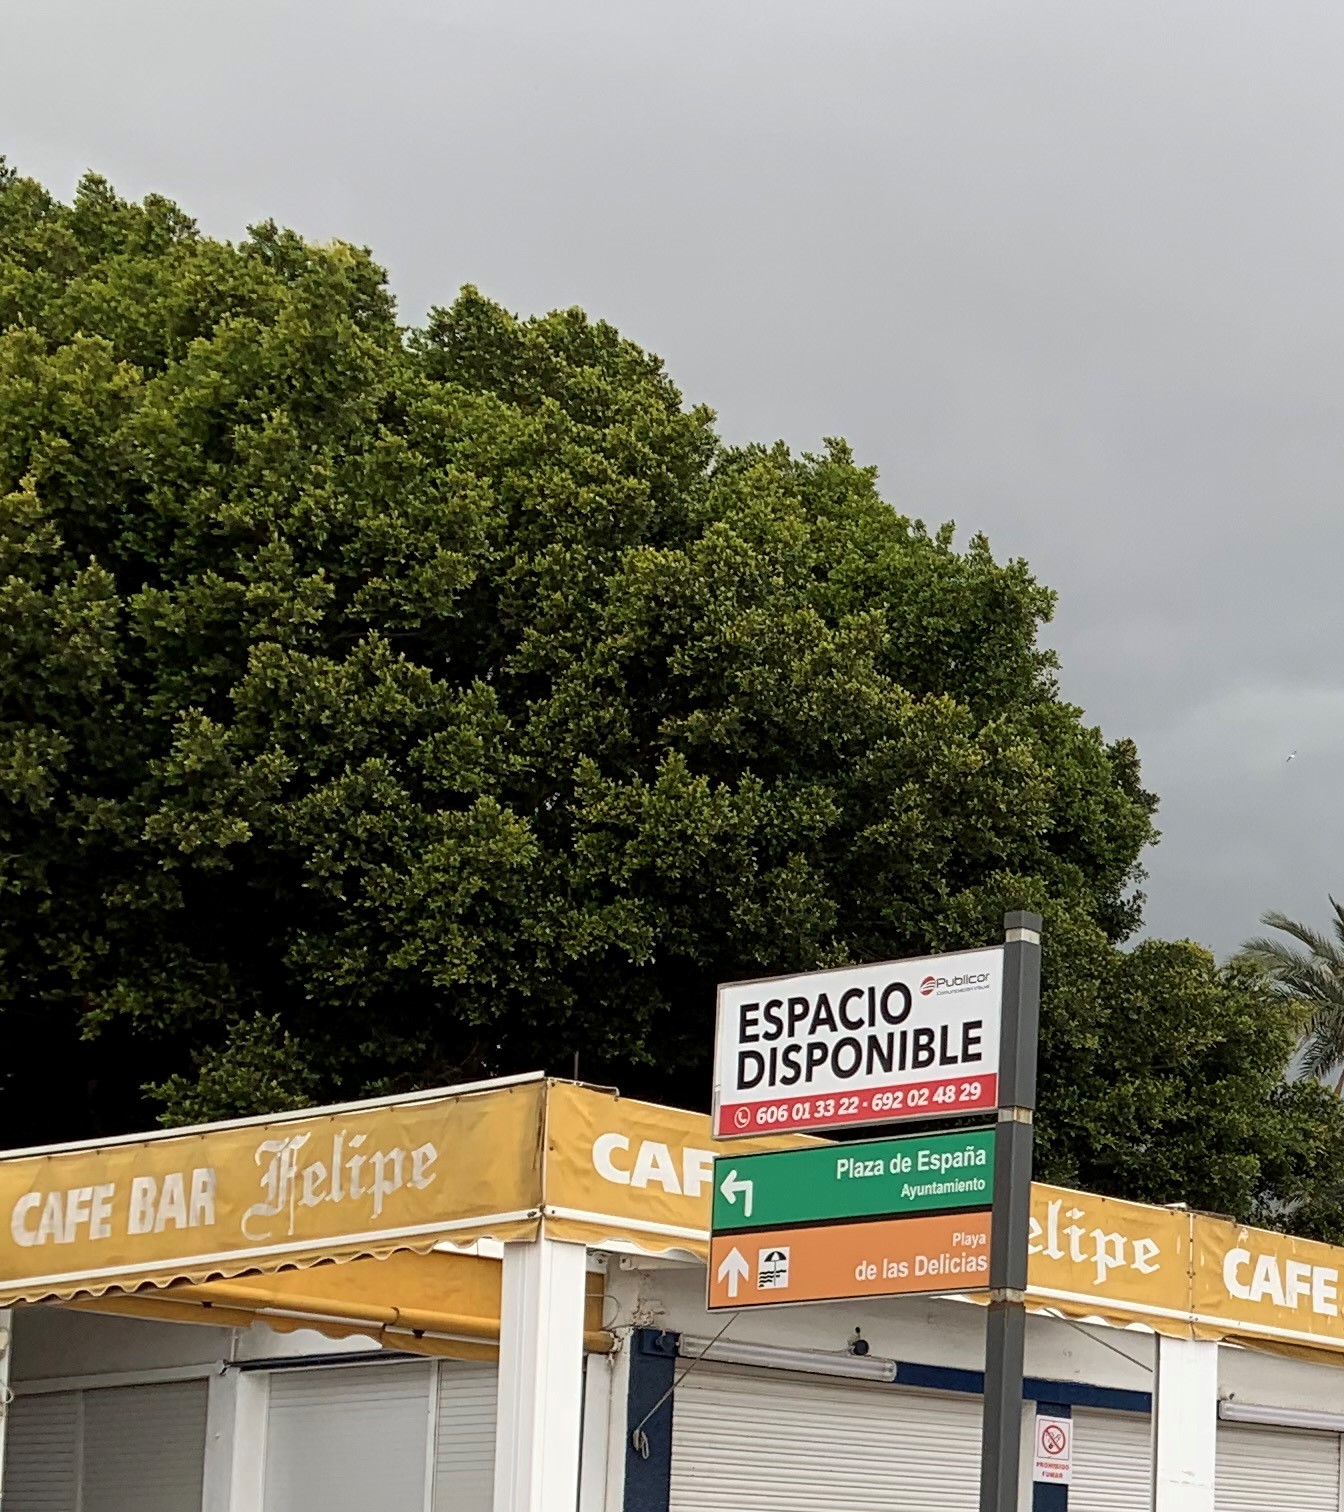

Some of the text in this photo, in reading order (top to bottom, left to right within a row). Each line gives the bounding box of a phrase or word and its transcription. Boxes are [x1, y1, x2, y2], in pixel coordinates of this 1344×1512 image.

[936, 973, 990, 988] Publicor
[738, 981, 912, 1044] ESPACIO
[737, 1019, 983, 1091] DISPONIBLE
[756, 1104, 788, 1125] 606
[792, 1101, 811, 1121] 01
[813, 1099, 835, 1118] 33
[838, 1096, 859, 1116] 22
[872, 1089, 903, 1111] 692
[907, 1087, 929, 1107] 02
[932, 1084, 956, 1104] 48
[958, 1081, 982, 1101] 29
[836, 1146, 986, 1180] Plaza de España
[10, 1130, 438, 1247] CAFE BAR Felipe
[900, 1177, 985, 1200] Ayuntamiento
[592, 1132, 1160, 1286] CAF elipe
[952, 1231, 987, 1249] Playa
[854, 1252, 988, 1282] de las Delicias
[1222, 1247, 1339, 1317] CAFE
[1036, 1461, 1070, 1470] PROHIBIDO
[1041, 1470, 1063, 1479] FUMAR
